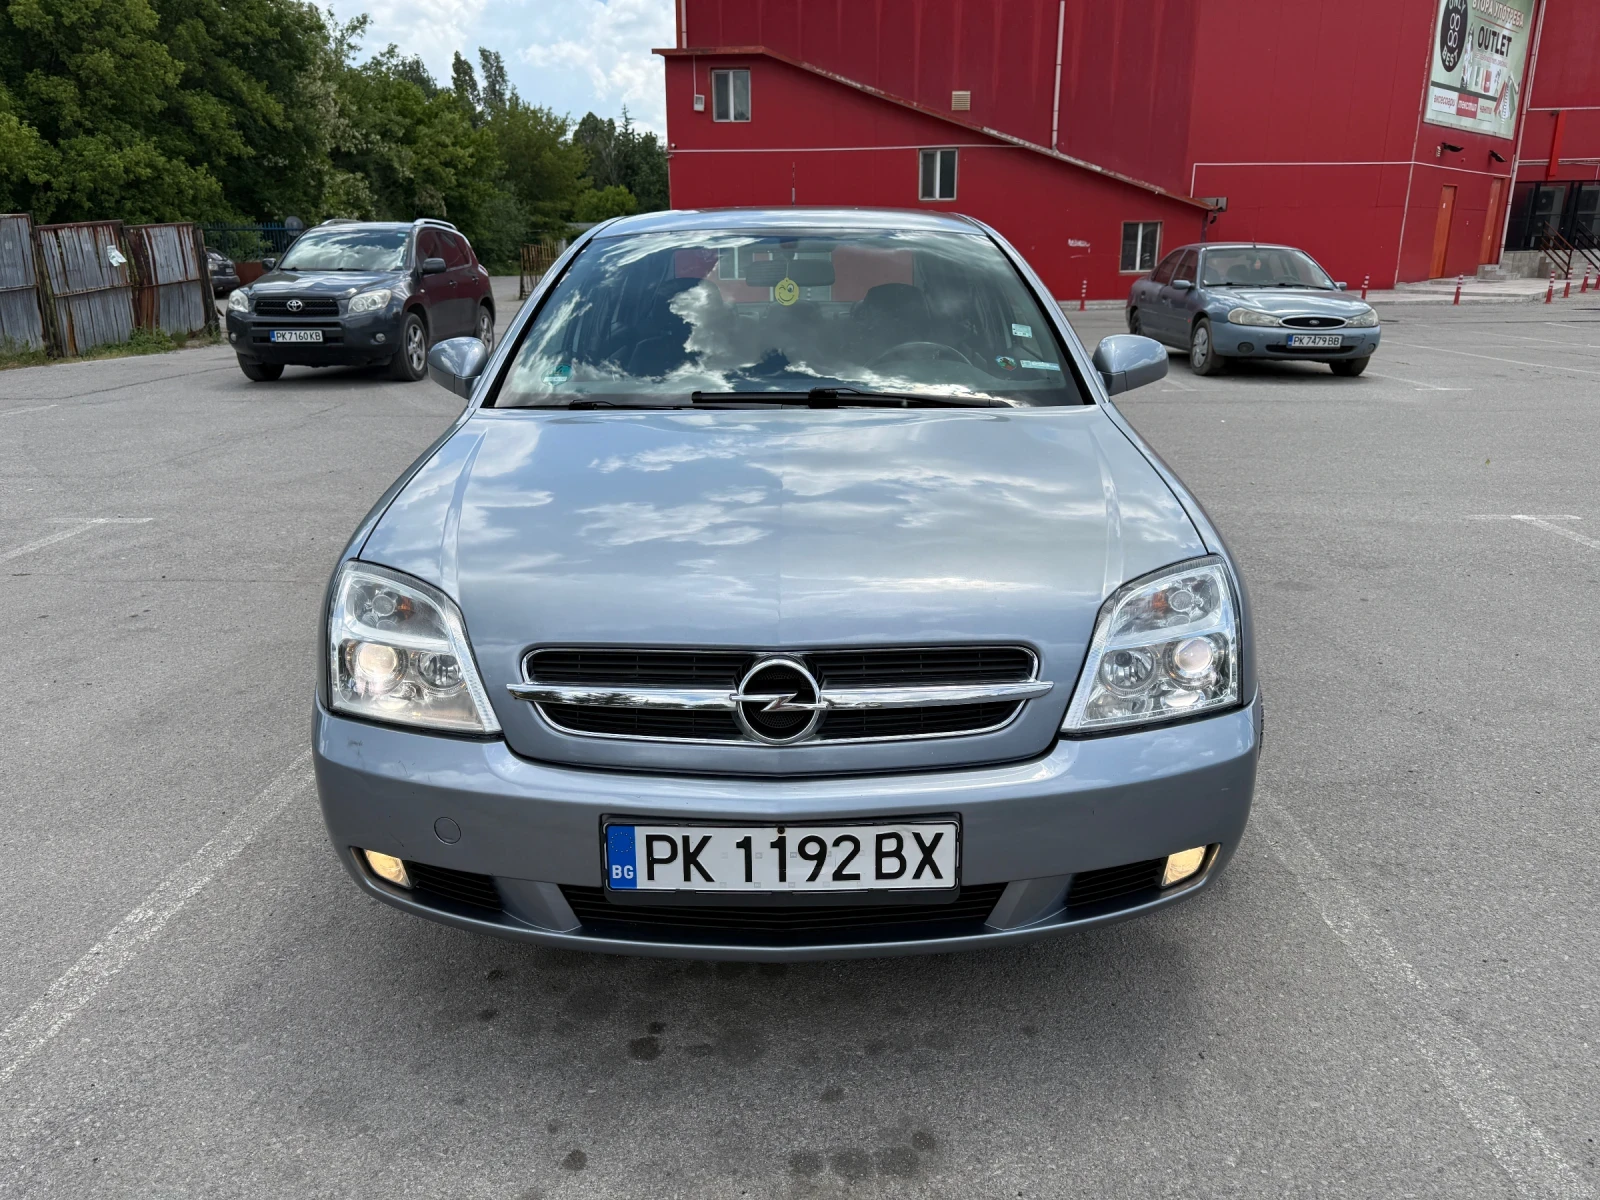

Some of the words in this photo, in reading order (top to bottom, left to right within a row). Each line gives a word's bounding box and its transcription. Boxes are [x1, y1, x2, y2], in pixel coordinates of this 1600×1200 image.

[1493, 2, 1525, 28] УПОТРЕБА
[1477, 25, 1513, 57] OUTLET
[1442, 45, 1459, 67] BEST
[611, 864, 634, 880] BG
